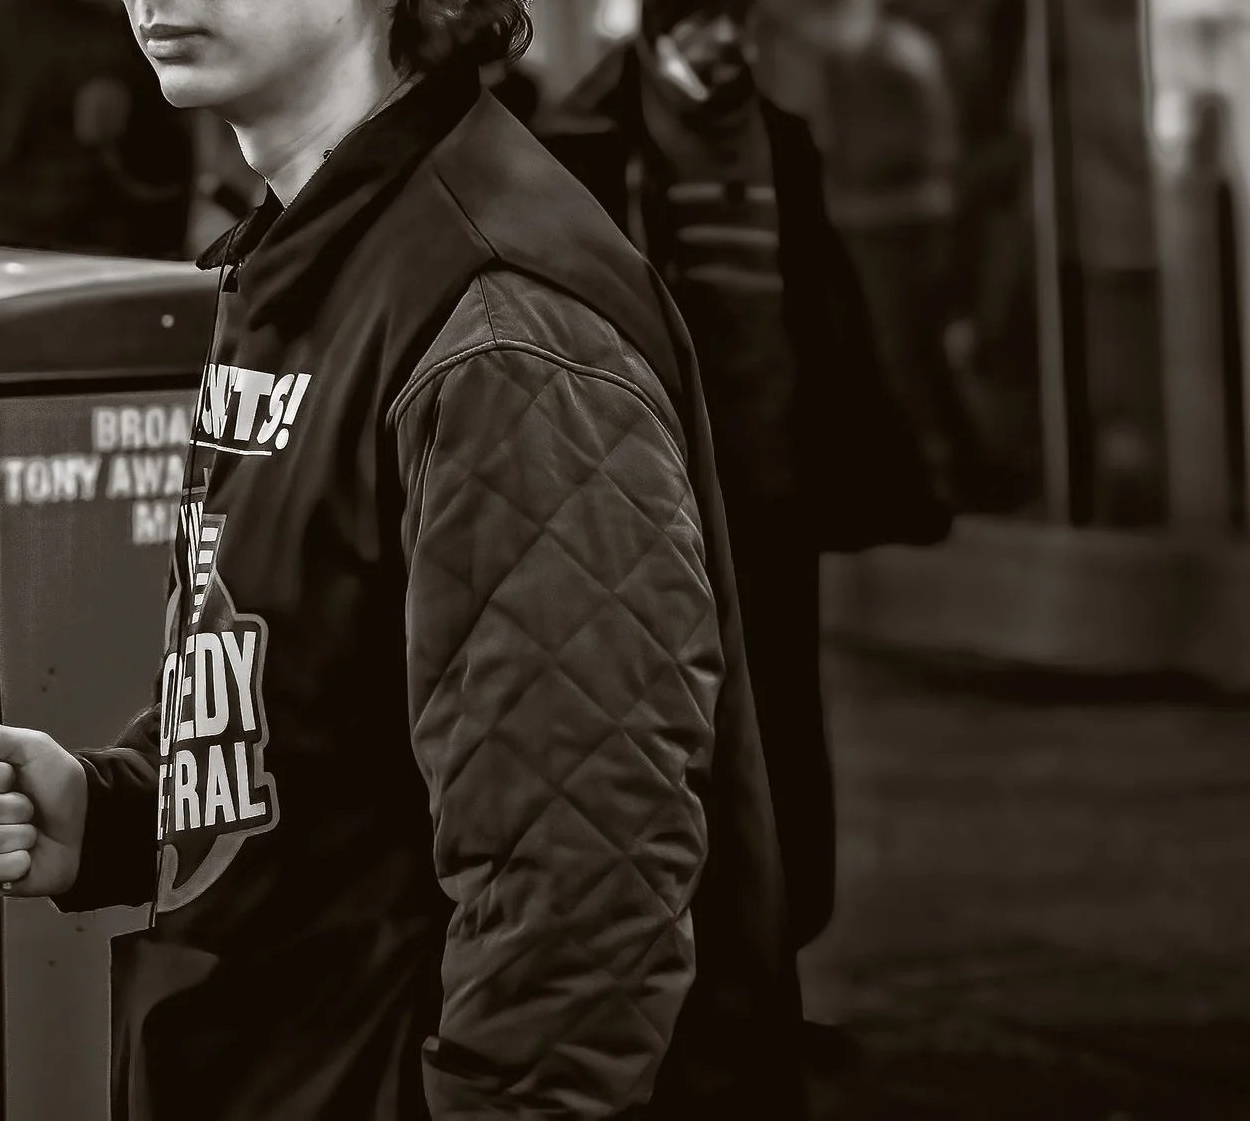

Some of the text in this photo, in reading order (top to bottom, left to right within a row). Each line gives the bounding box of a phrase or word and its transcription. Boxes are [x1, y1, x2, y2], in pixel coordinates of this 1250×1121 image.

[95, 407, 190, 451] BROA
[4, 455, 184, 502] TONY AWA
